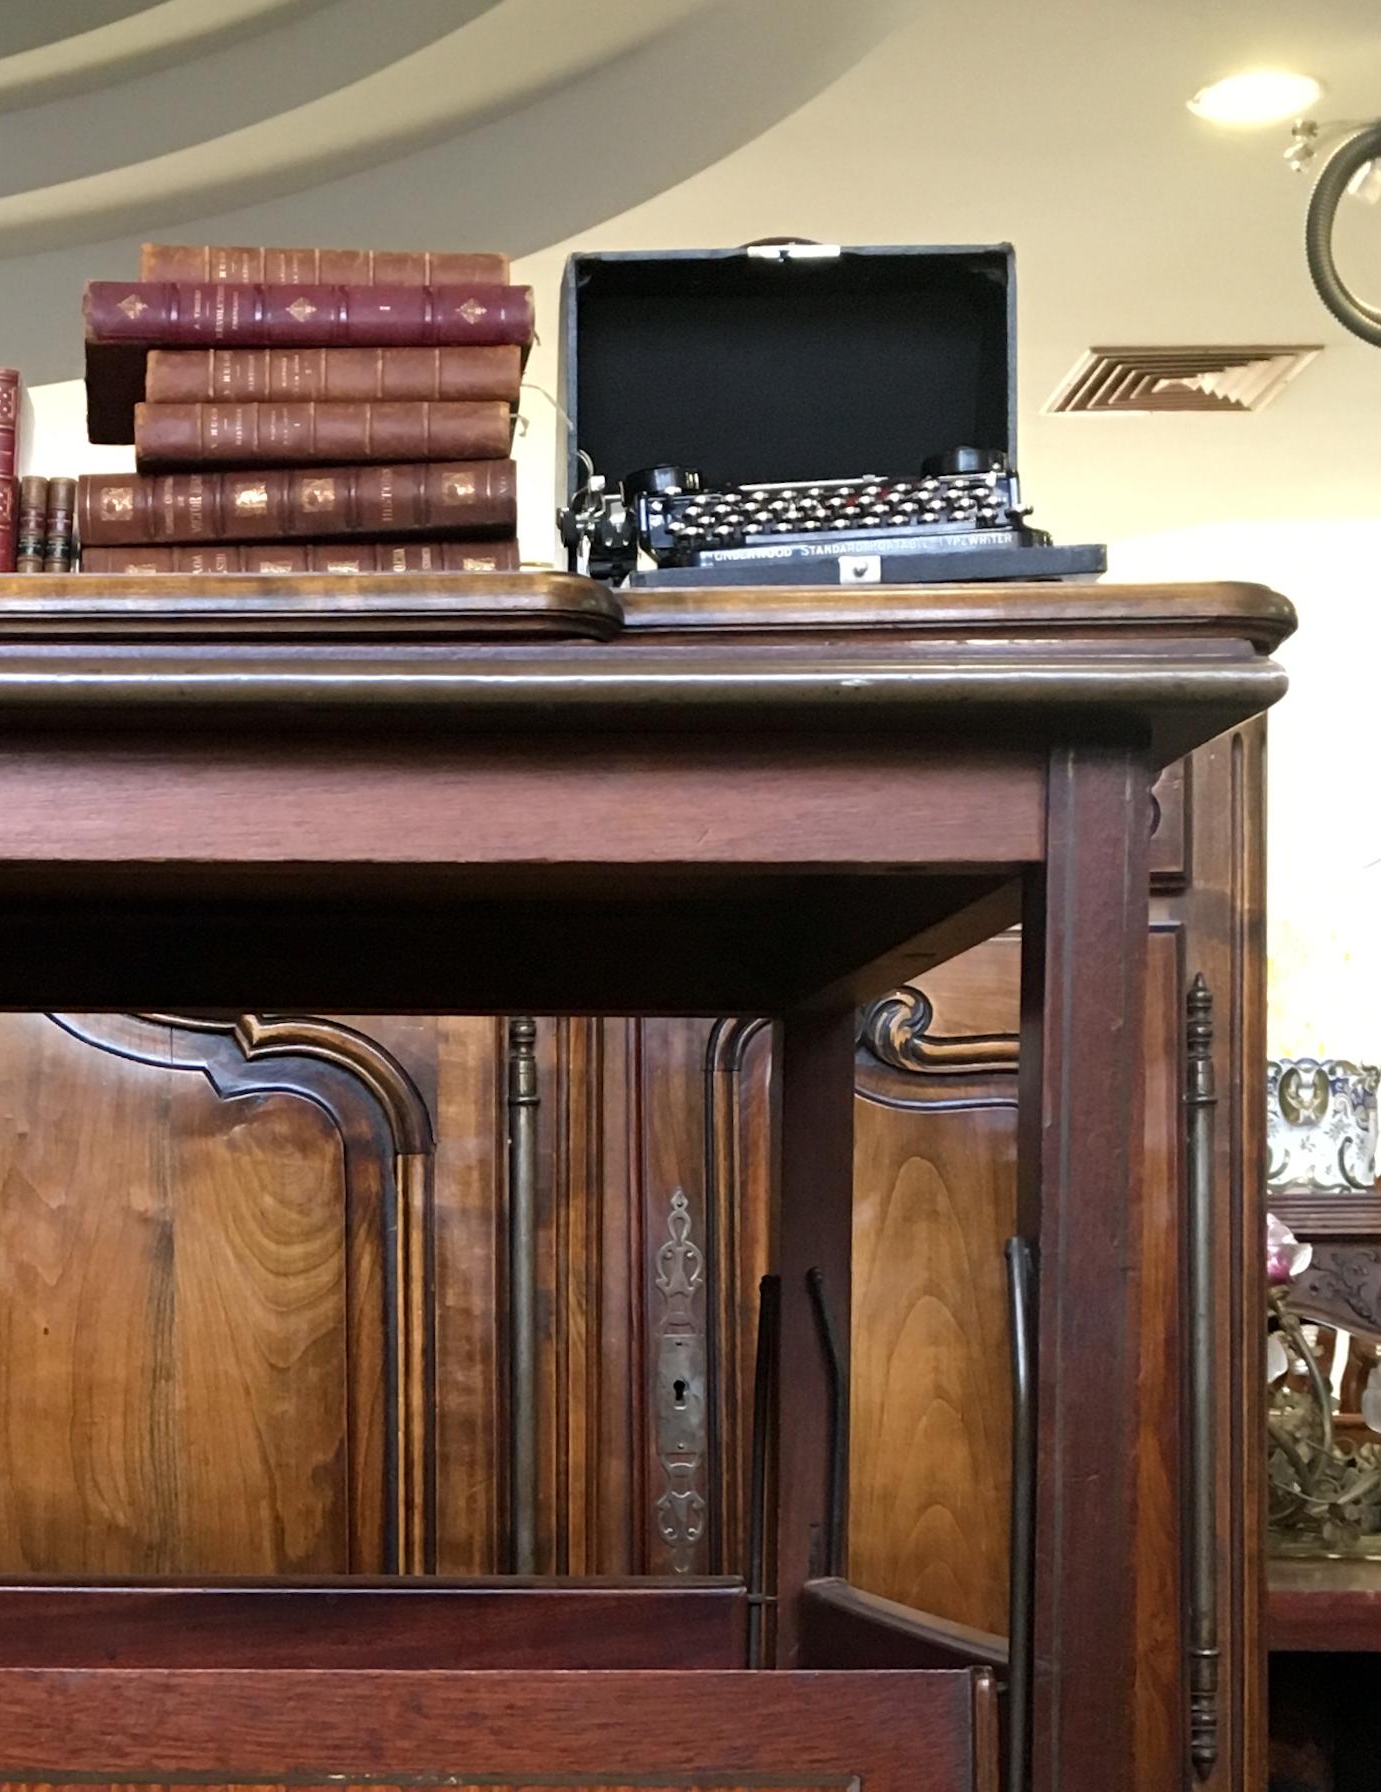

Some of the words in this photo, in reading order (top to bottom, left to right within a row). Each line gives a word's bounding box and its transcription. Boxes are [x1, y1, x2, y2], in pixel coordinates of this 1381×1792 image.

[714, 546, 793, 562] UNDERWOOD
[800, 540, 867, 557] STANDARD
[939, 532, 1013, 547] TYPEWRITER
